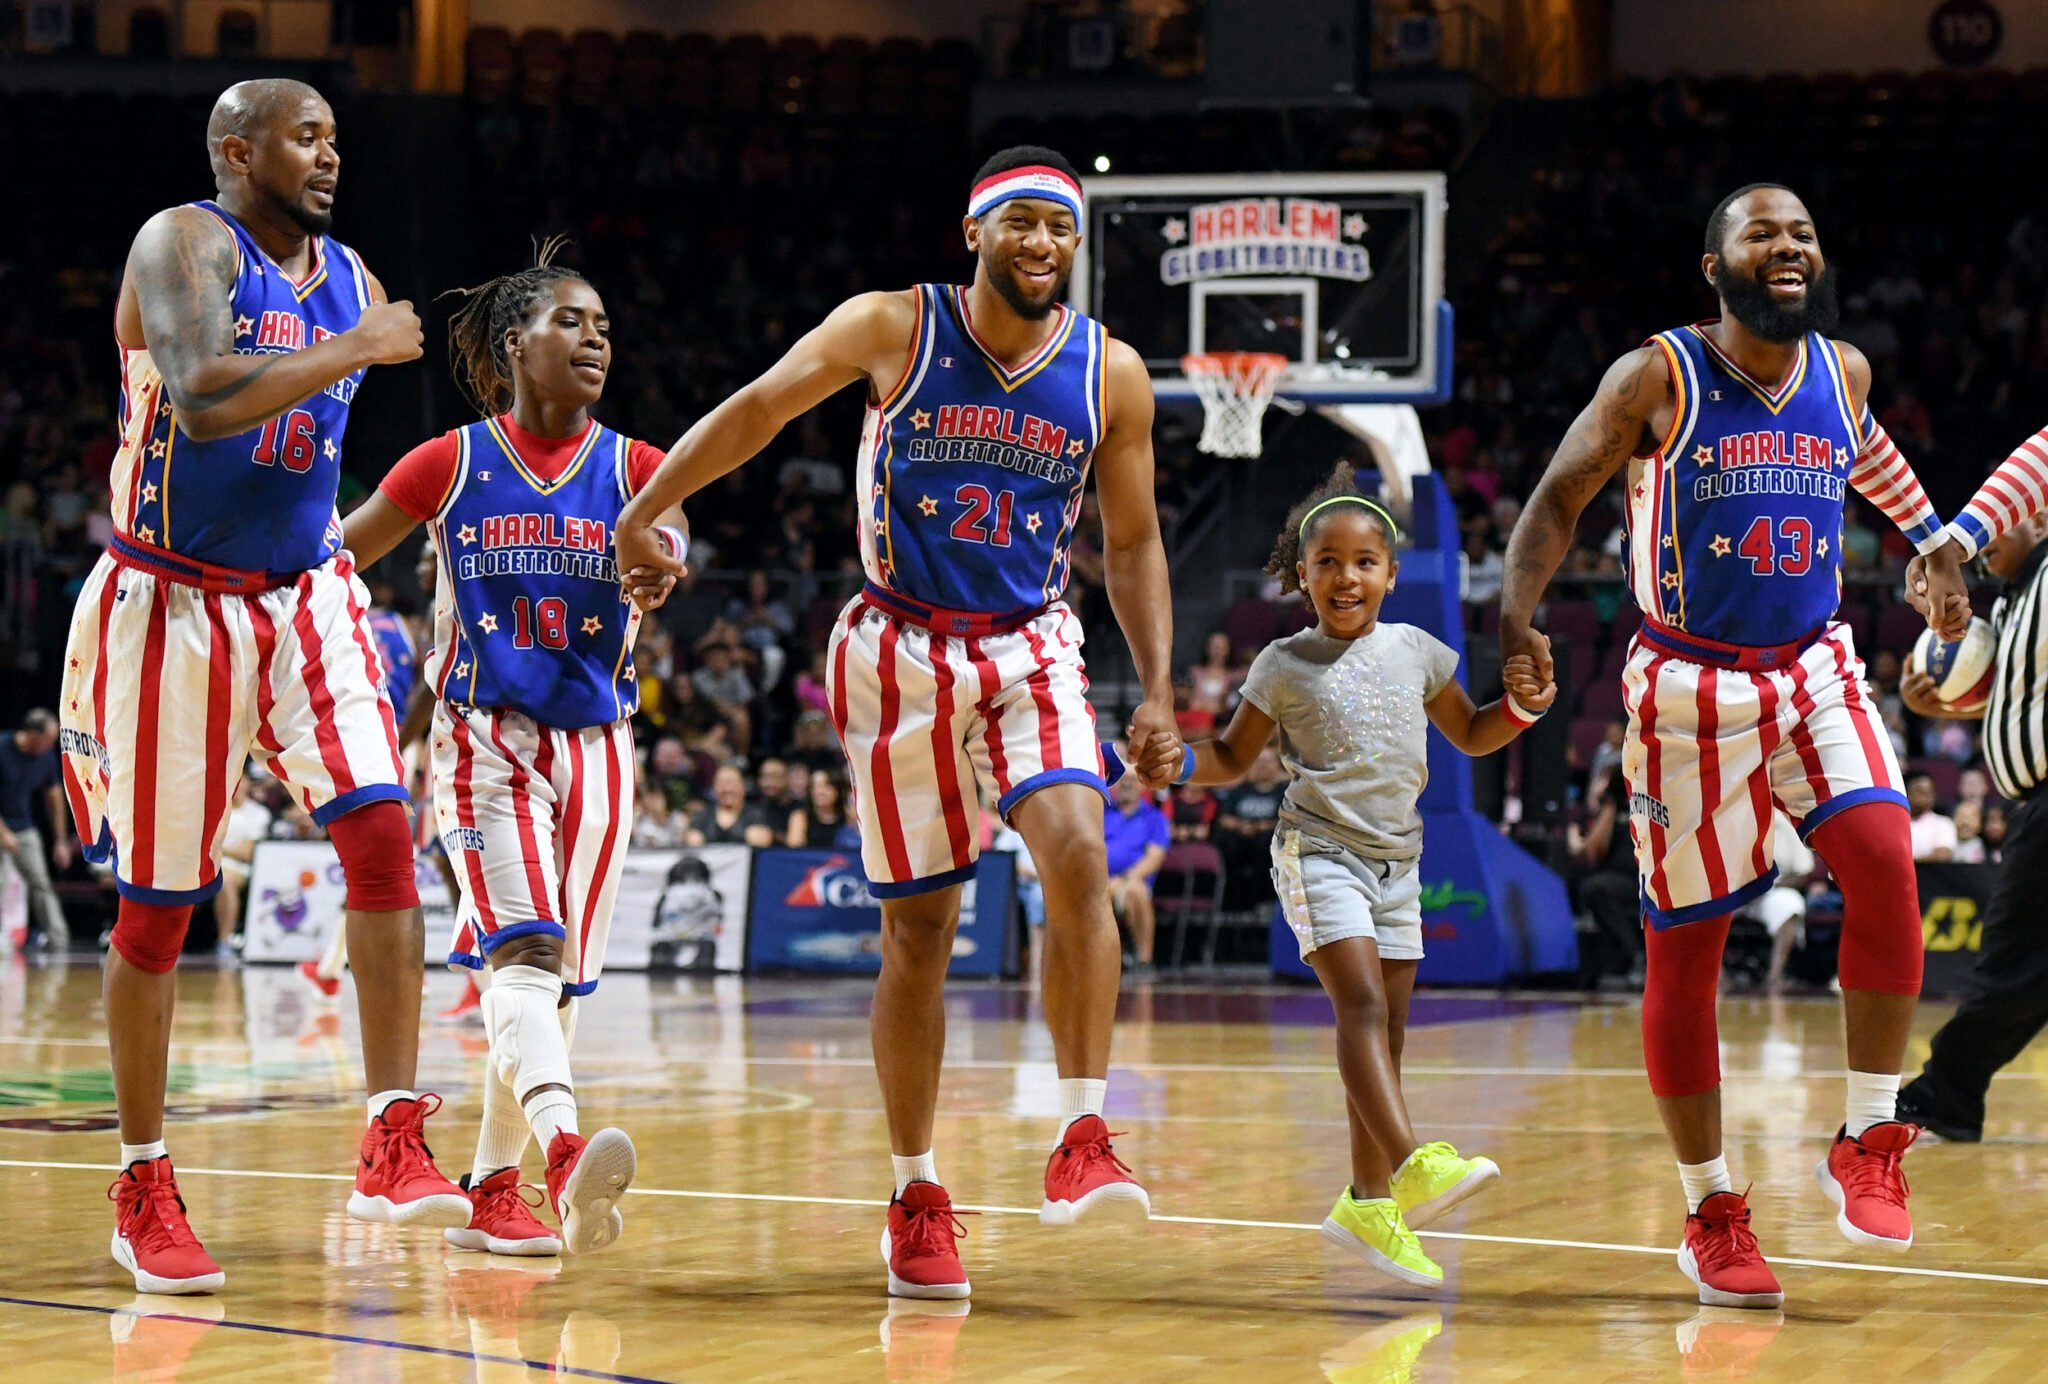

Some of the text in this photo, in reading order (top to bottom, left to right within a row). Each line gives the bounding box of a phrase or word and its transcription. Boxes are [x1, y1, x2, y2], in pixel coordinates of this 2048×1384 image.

[1941, 12, 1992, 47] 110
[1191, 199, 1340, 245] HARLEM
[256, 311, 338, 350] HARL
[252, 409, 315, 474] 16
[935, 405, 1067, 459] HARLEM
[1720, 431, 1832, 472] HARLEM
[908, 438, 1075, 483] GLOBETROTTERS
[482, 513, 605, 554] HARLEM
[950, 483, 1015, 548] 21
[1738, 516, 1812, 576] 43
[512, 596, 569, 650] 18
